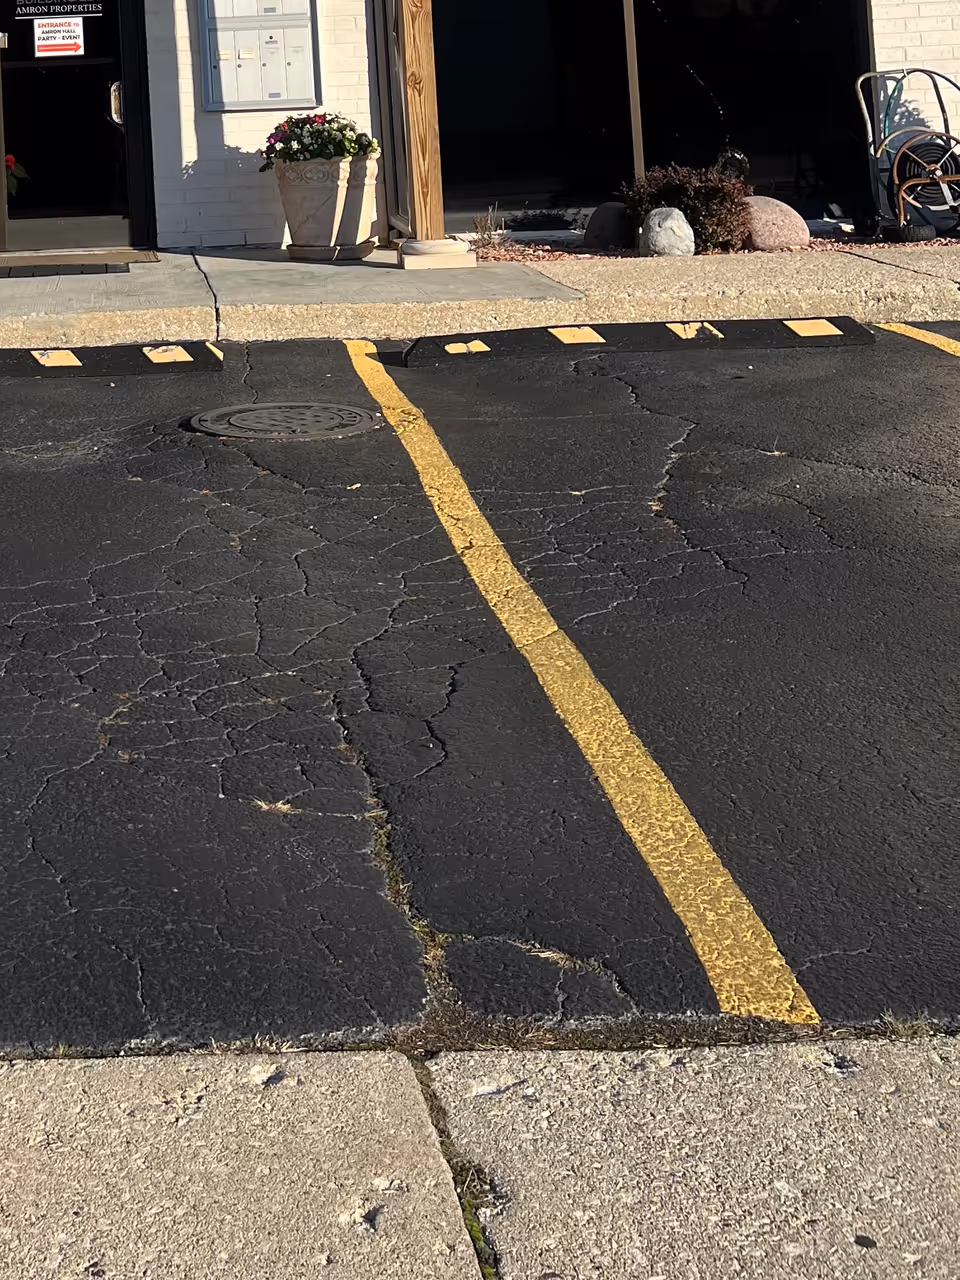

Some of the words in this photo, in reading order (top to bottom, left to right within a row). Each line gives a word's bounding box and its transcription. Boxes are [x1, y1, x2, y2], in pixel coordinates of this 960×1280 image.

[15, 5, 48, 14] AMRON
[50, 3, 102, 13] PROPERTIES
[37, 21, 72, 29] ENTRANCE
